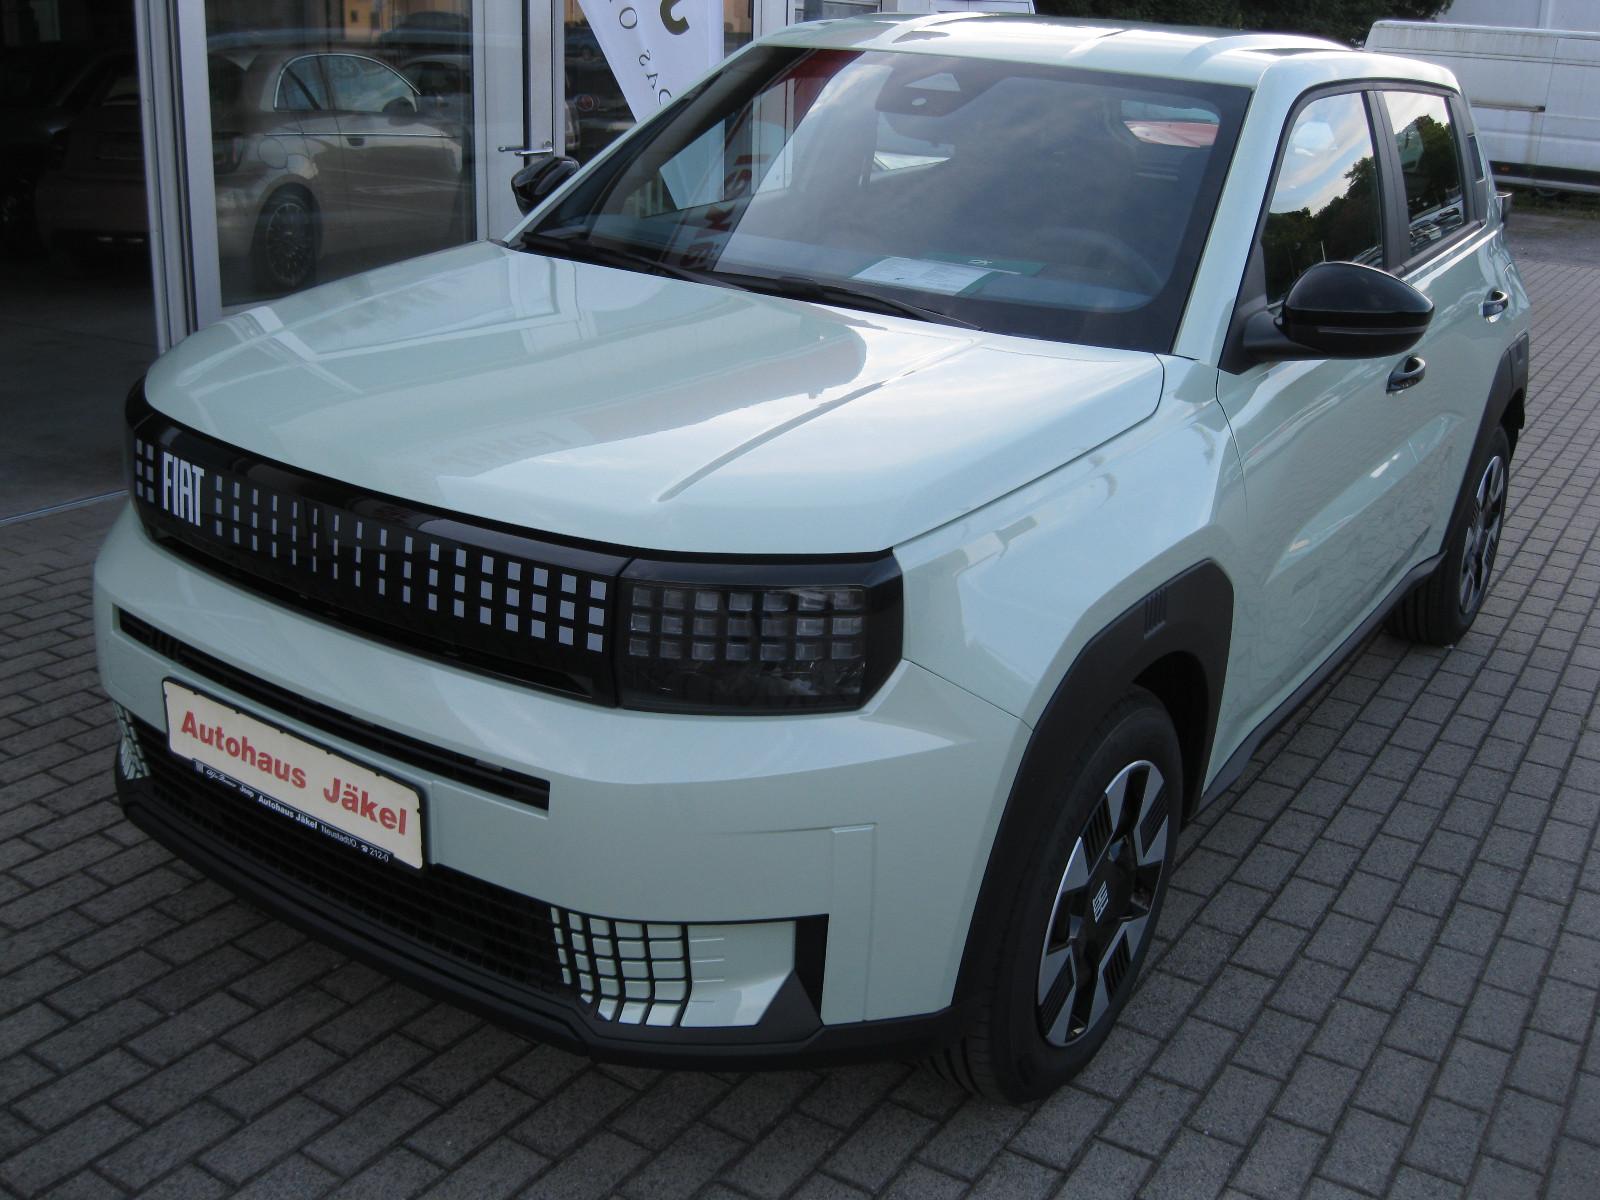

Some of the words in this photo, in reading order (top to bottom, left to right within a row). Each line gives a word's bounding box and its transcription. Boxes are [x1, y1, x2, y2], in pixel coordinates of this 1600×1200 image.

[163, 451, 205, 527] FIAT
[181, 711, 307, 789] Autohaus
[323, 777, 407, 835] Jäkel
[258, 795, 294, 818] Autohaus
[295, 811, 318, 829] Jäkel
[369, 847, 389, 863] 212-0
